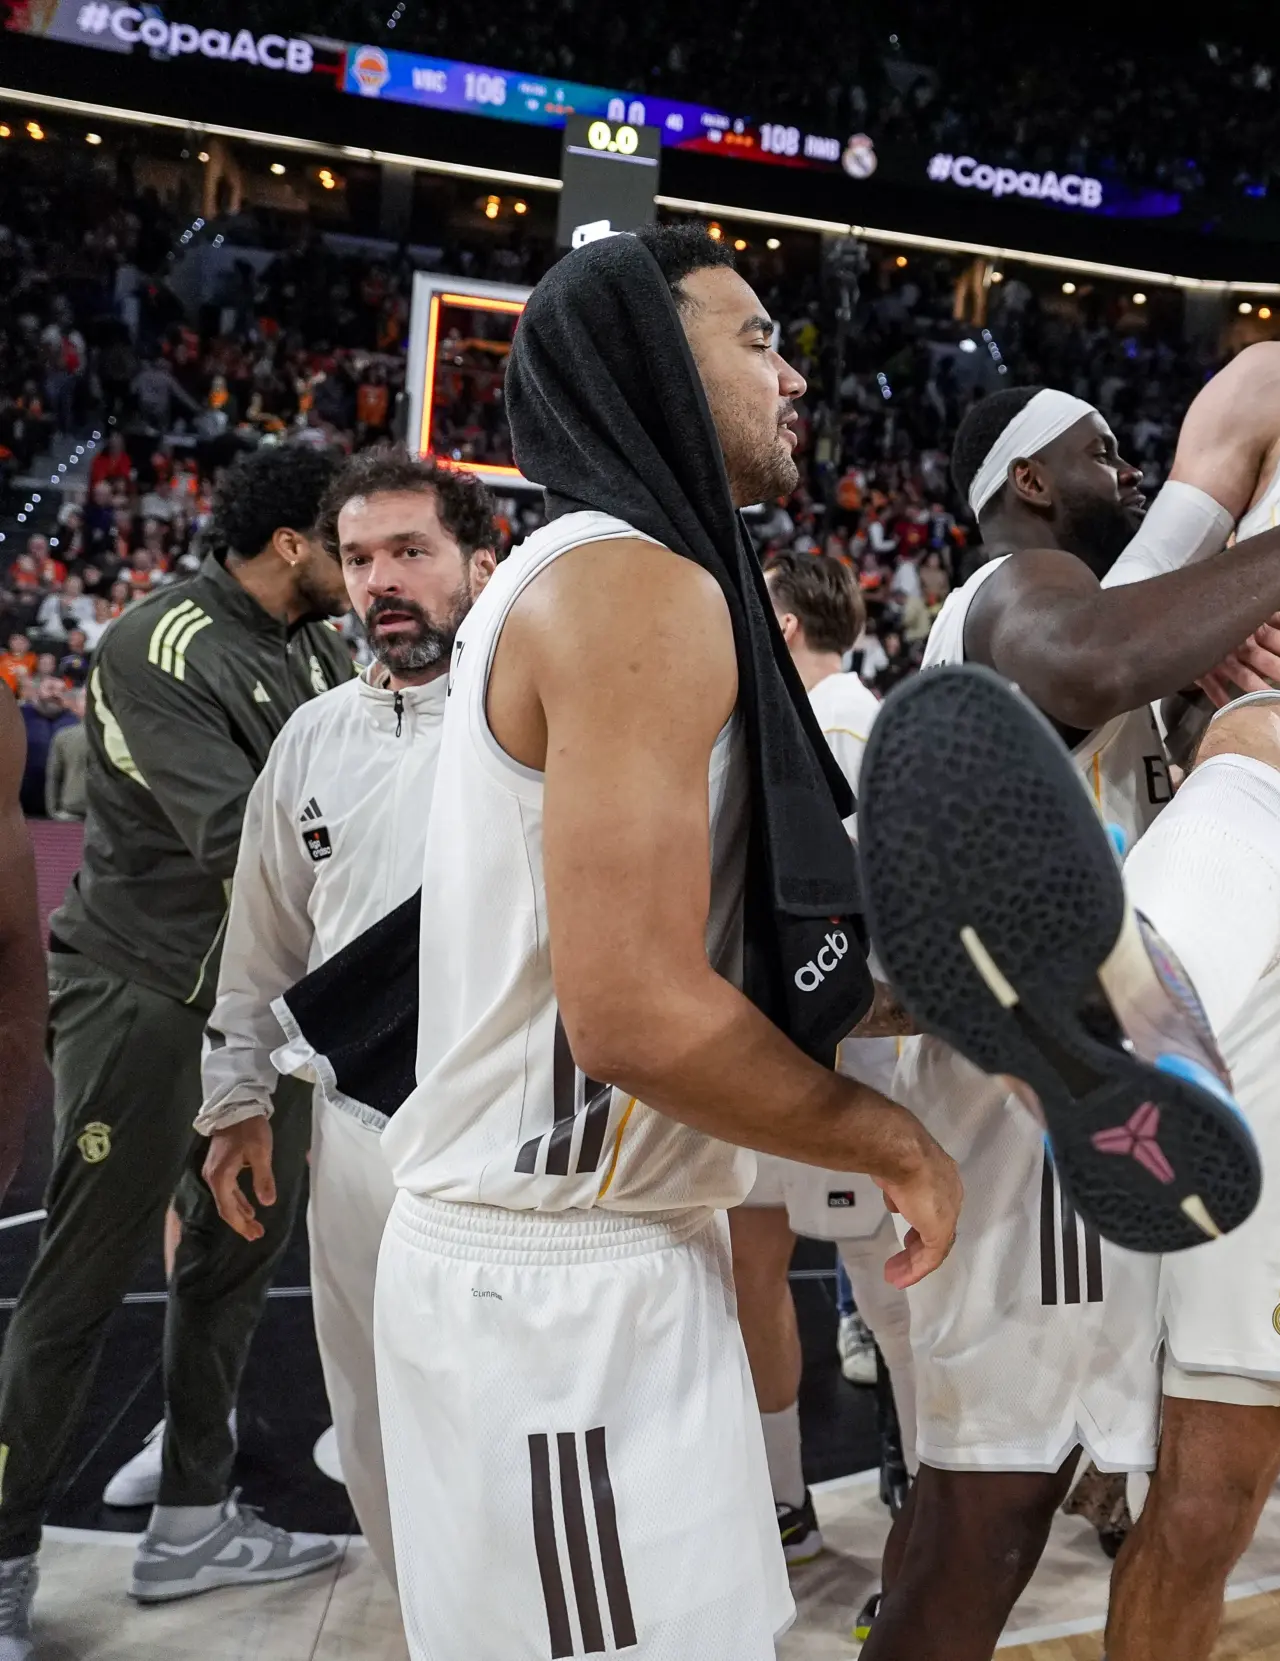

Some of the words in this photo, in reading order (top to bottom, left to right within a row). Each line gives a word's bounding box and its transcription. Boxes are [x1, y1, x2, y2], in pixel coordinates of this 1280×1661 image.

[76, 2, 314, 74] #CopaACB
[464, 71, 507, 106] 106
[588, 121, 638, 155] 0.0
[759, 123, 799, 156] 108
[927, 152, 1103, 209] #CopaACB
[794, 929, 849, 992] acb
